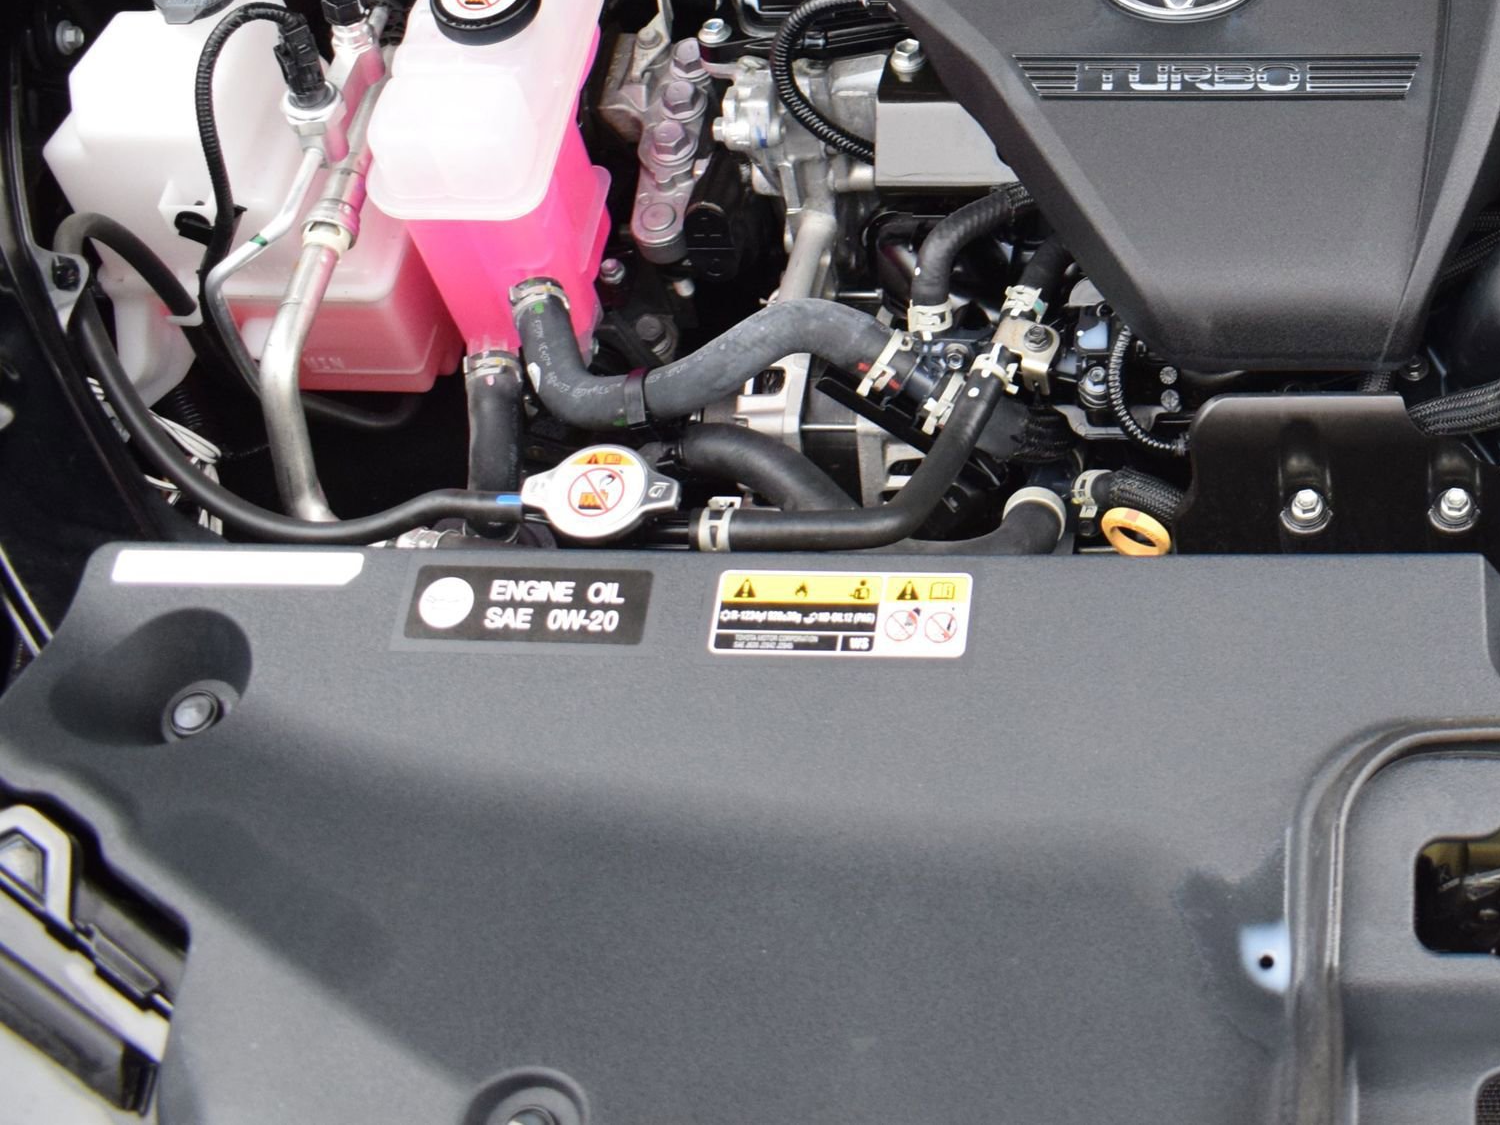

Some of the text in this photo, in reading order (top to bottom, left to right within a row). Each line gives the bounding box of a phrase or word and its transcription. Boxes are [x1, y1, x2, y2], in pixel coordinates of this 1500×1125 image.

[1085, 63, 1300, 92] TURBO
[488, 579, 626, 605] ENGINE OIL
[483, 606, 620, 633] SAE 0W-20
